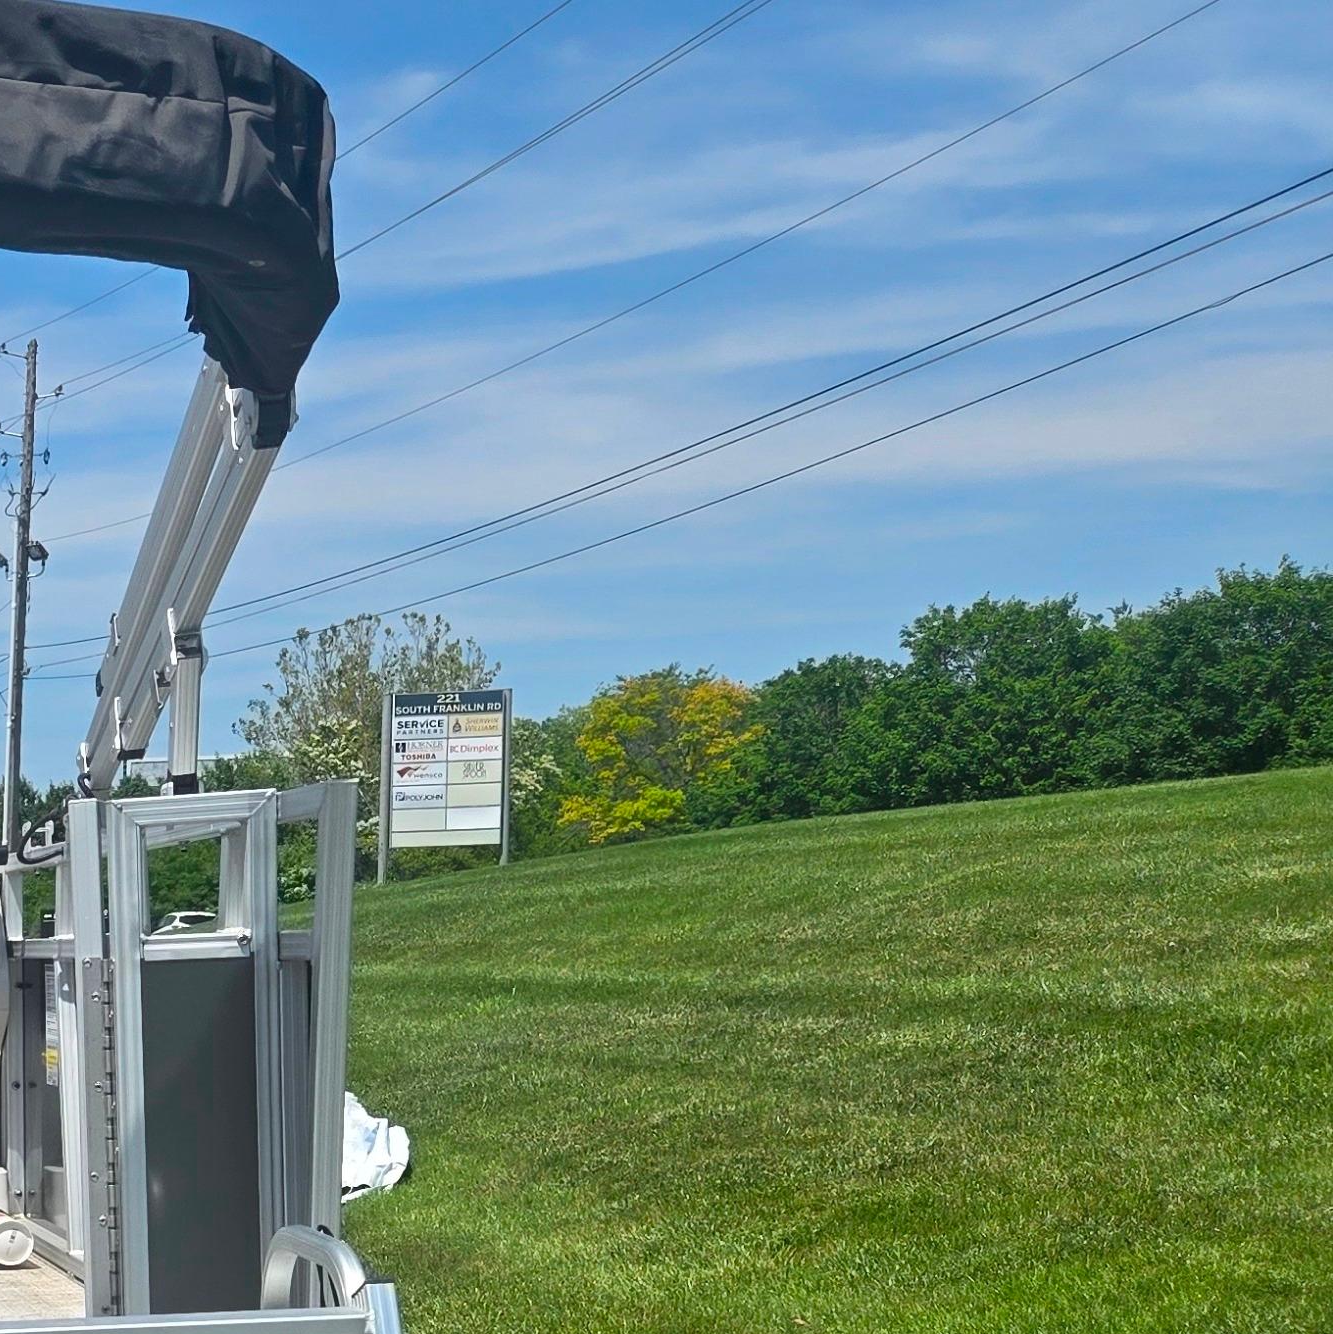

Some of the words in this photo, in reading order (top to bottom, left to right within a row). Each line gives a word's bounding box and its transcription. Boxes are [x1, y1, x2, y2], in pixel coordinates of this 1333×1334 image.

[436, 693, 461, 703] 221
[396, 705, 431, 715] SOUTH
[433, 703, 484, 713] FRANKLIN
[487, 702, 501, 711] RD
[460, 743, 499, 753] Dimplex
[401, 753, 437, 761] TOSHIBA
